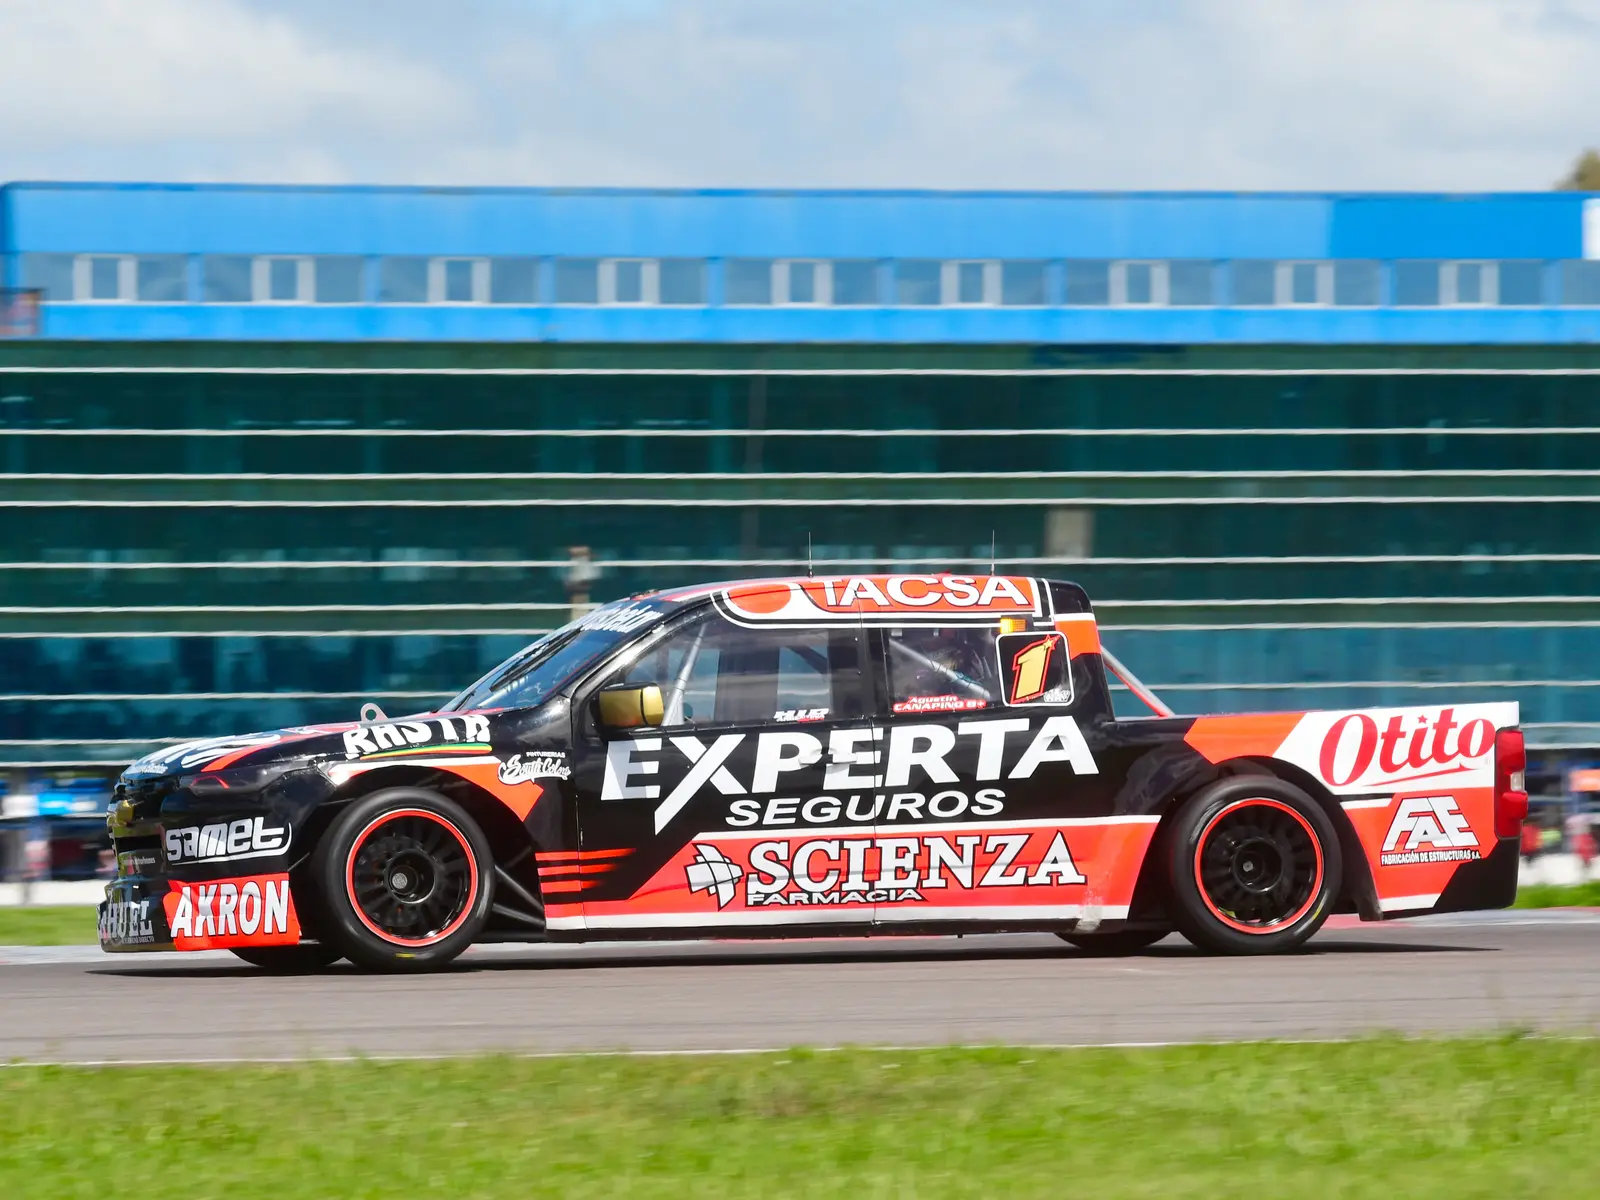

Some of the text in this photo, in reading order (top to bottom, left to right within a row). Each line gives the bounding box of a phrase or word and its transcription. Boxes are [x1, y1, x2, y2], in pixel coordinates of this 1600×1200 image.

[815, 576, 1032, 607] TACSA
[1011, 637, 1058, 704] 1
[600, 715, 1099, 836] EXPERTA
[1319, 708, 1496, 787] Otito
[725, 788, 1006, 827] SEGUROS
[1381, 795, 1480, 851] FAE
[747, 831, 1087, 896] SCIENZA
[1419, 852, 1428, 862] DE
[1429, 849, 1471, 862] ESTRUCTURAS
[170, 880, 289, 939] AKRON
[747, 887, 923, 907] FARMACIA
